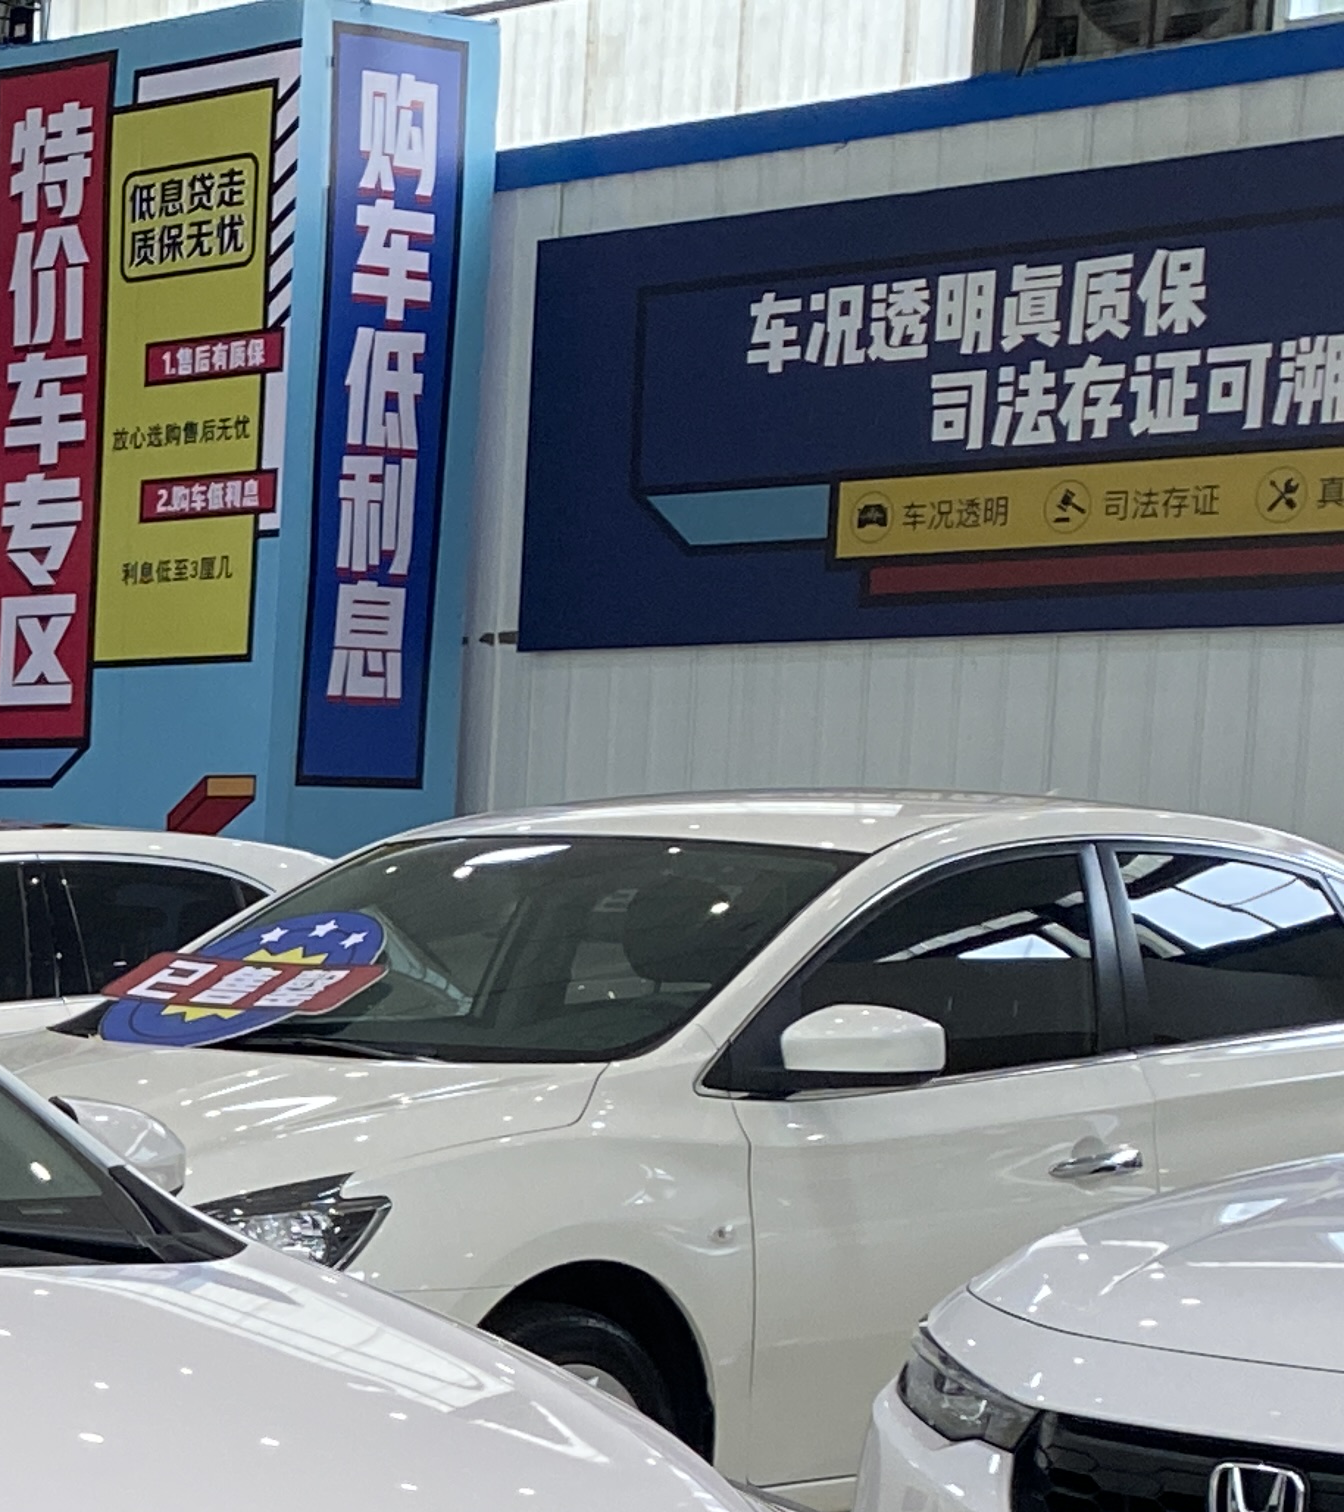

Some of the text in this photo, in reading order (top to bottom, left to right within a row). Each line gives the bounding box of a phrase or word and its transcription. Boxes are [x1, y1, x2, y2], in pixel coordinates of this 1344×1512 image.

[129, 168, 246, 223] 低息贷走
[129, 214, 245, 268] 质保无忧
[746, 247, 1207, 374] 车况透明真质保
[162, 339, 266, 376] 1.售后有质保
[326, 69, 439, 703] 购车低利息
[931, 334, 1344, 450] 司法存证可溯
[112, 414, 251, 451] 放心选购售后无忧
[902, 496, 1009, 532] 车况透明
[1104, 484, 1220, 521] 司法存证
